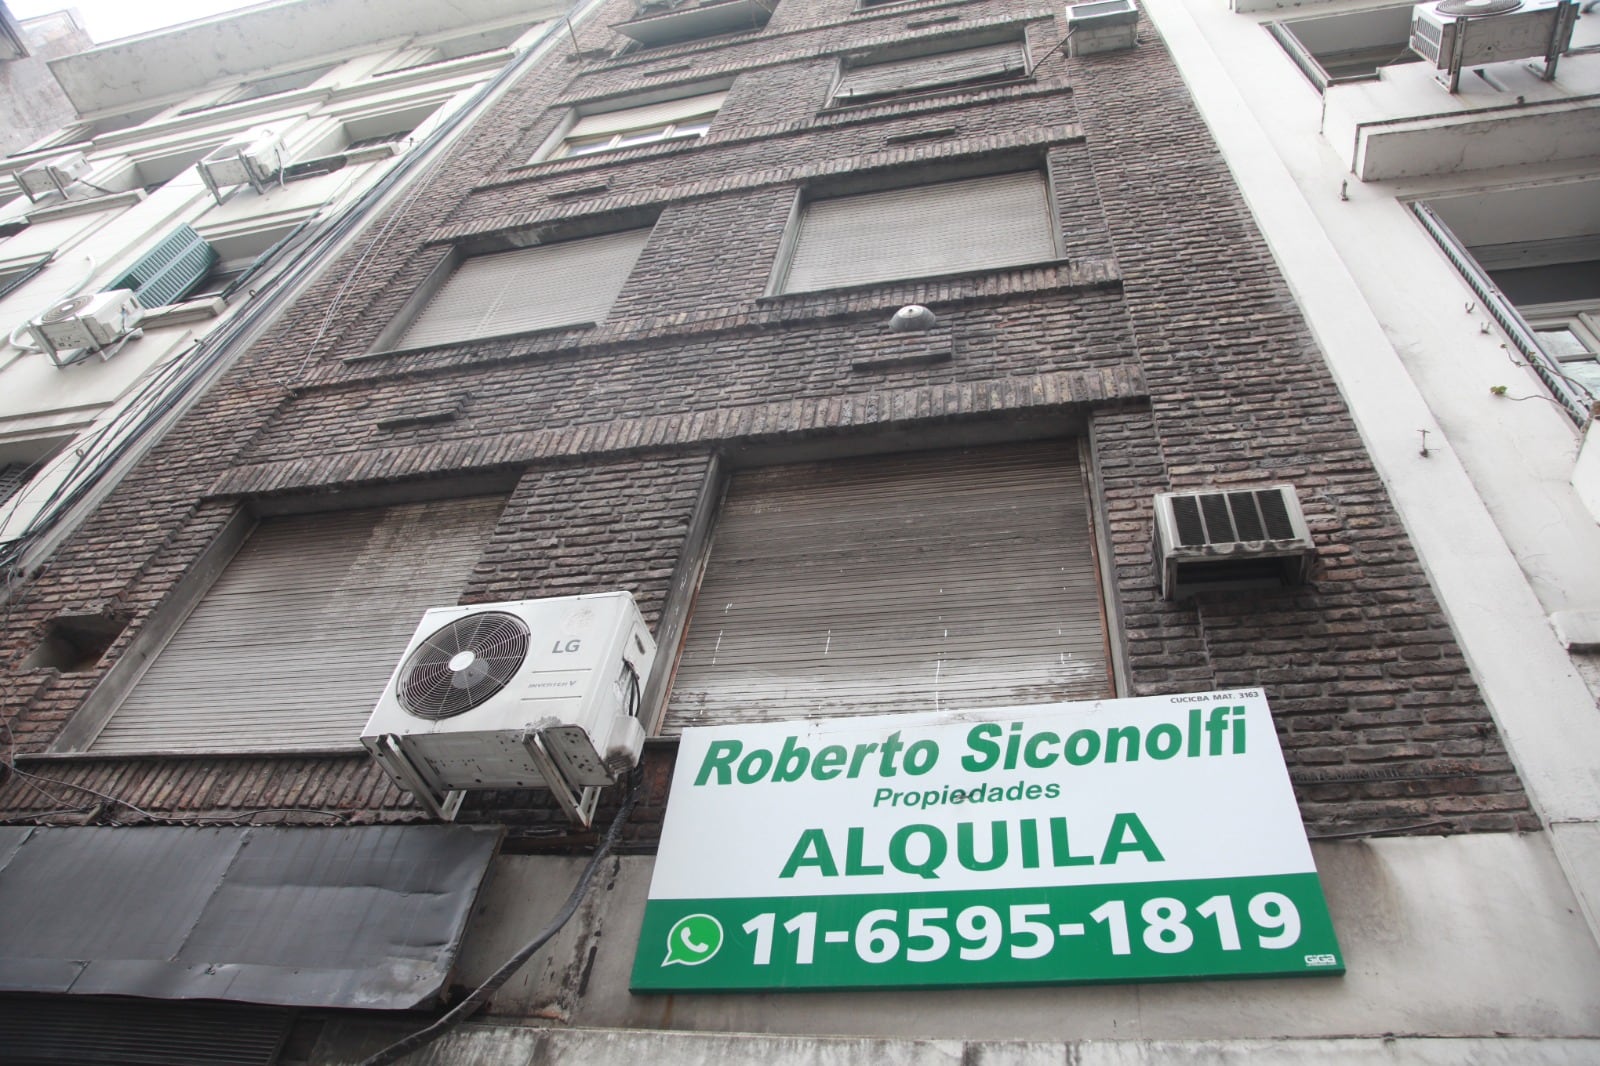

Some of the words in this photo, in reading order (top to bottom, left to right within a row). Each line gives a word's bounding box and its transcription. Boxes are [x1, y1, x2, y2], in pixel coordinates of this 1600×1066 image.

[552, 639, 581, 654] LG
[694, 735, 938, 786] Roberto
[961, 706, 1246, 772] Siconolfi
[873, 779, 1061, 810] Propiedades
[778, 812, 1165, 879] ALQUILA
[742, 892, 1301, 965] 11-6595-1819
